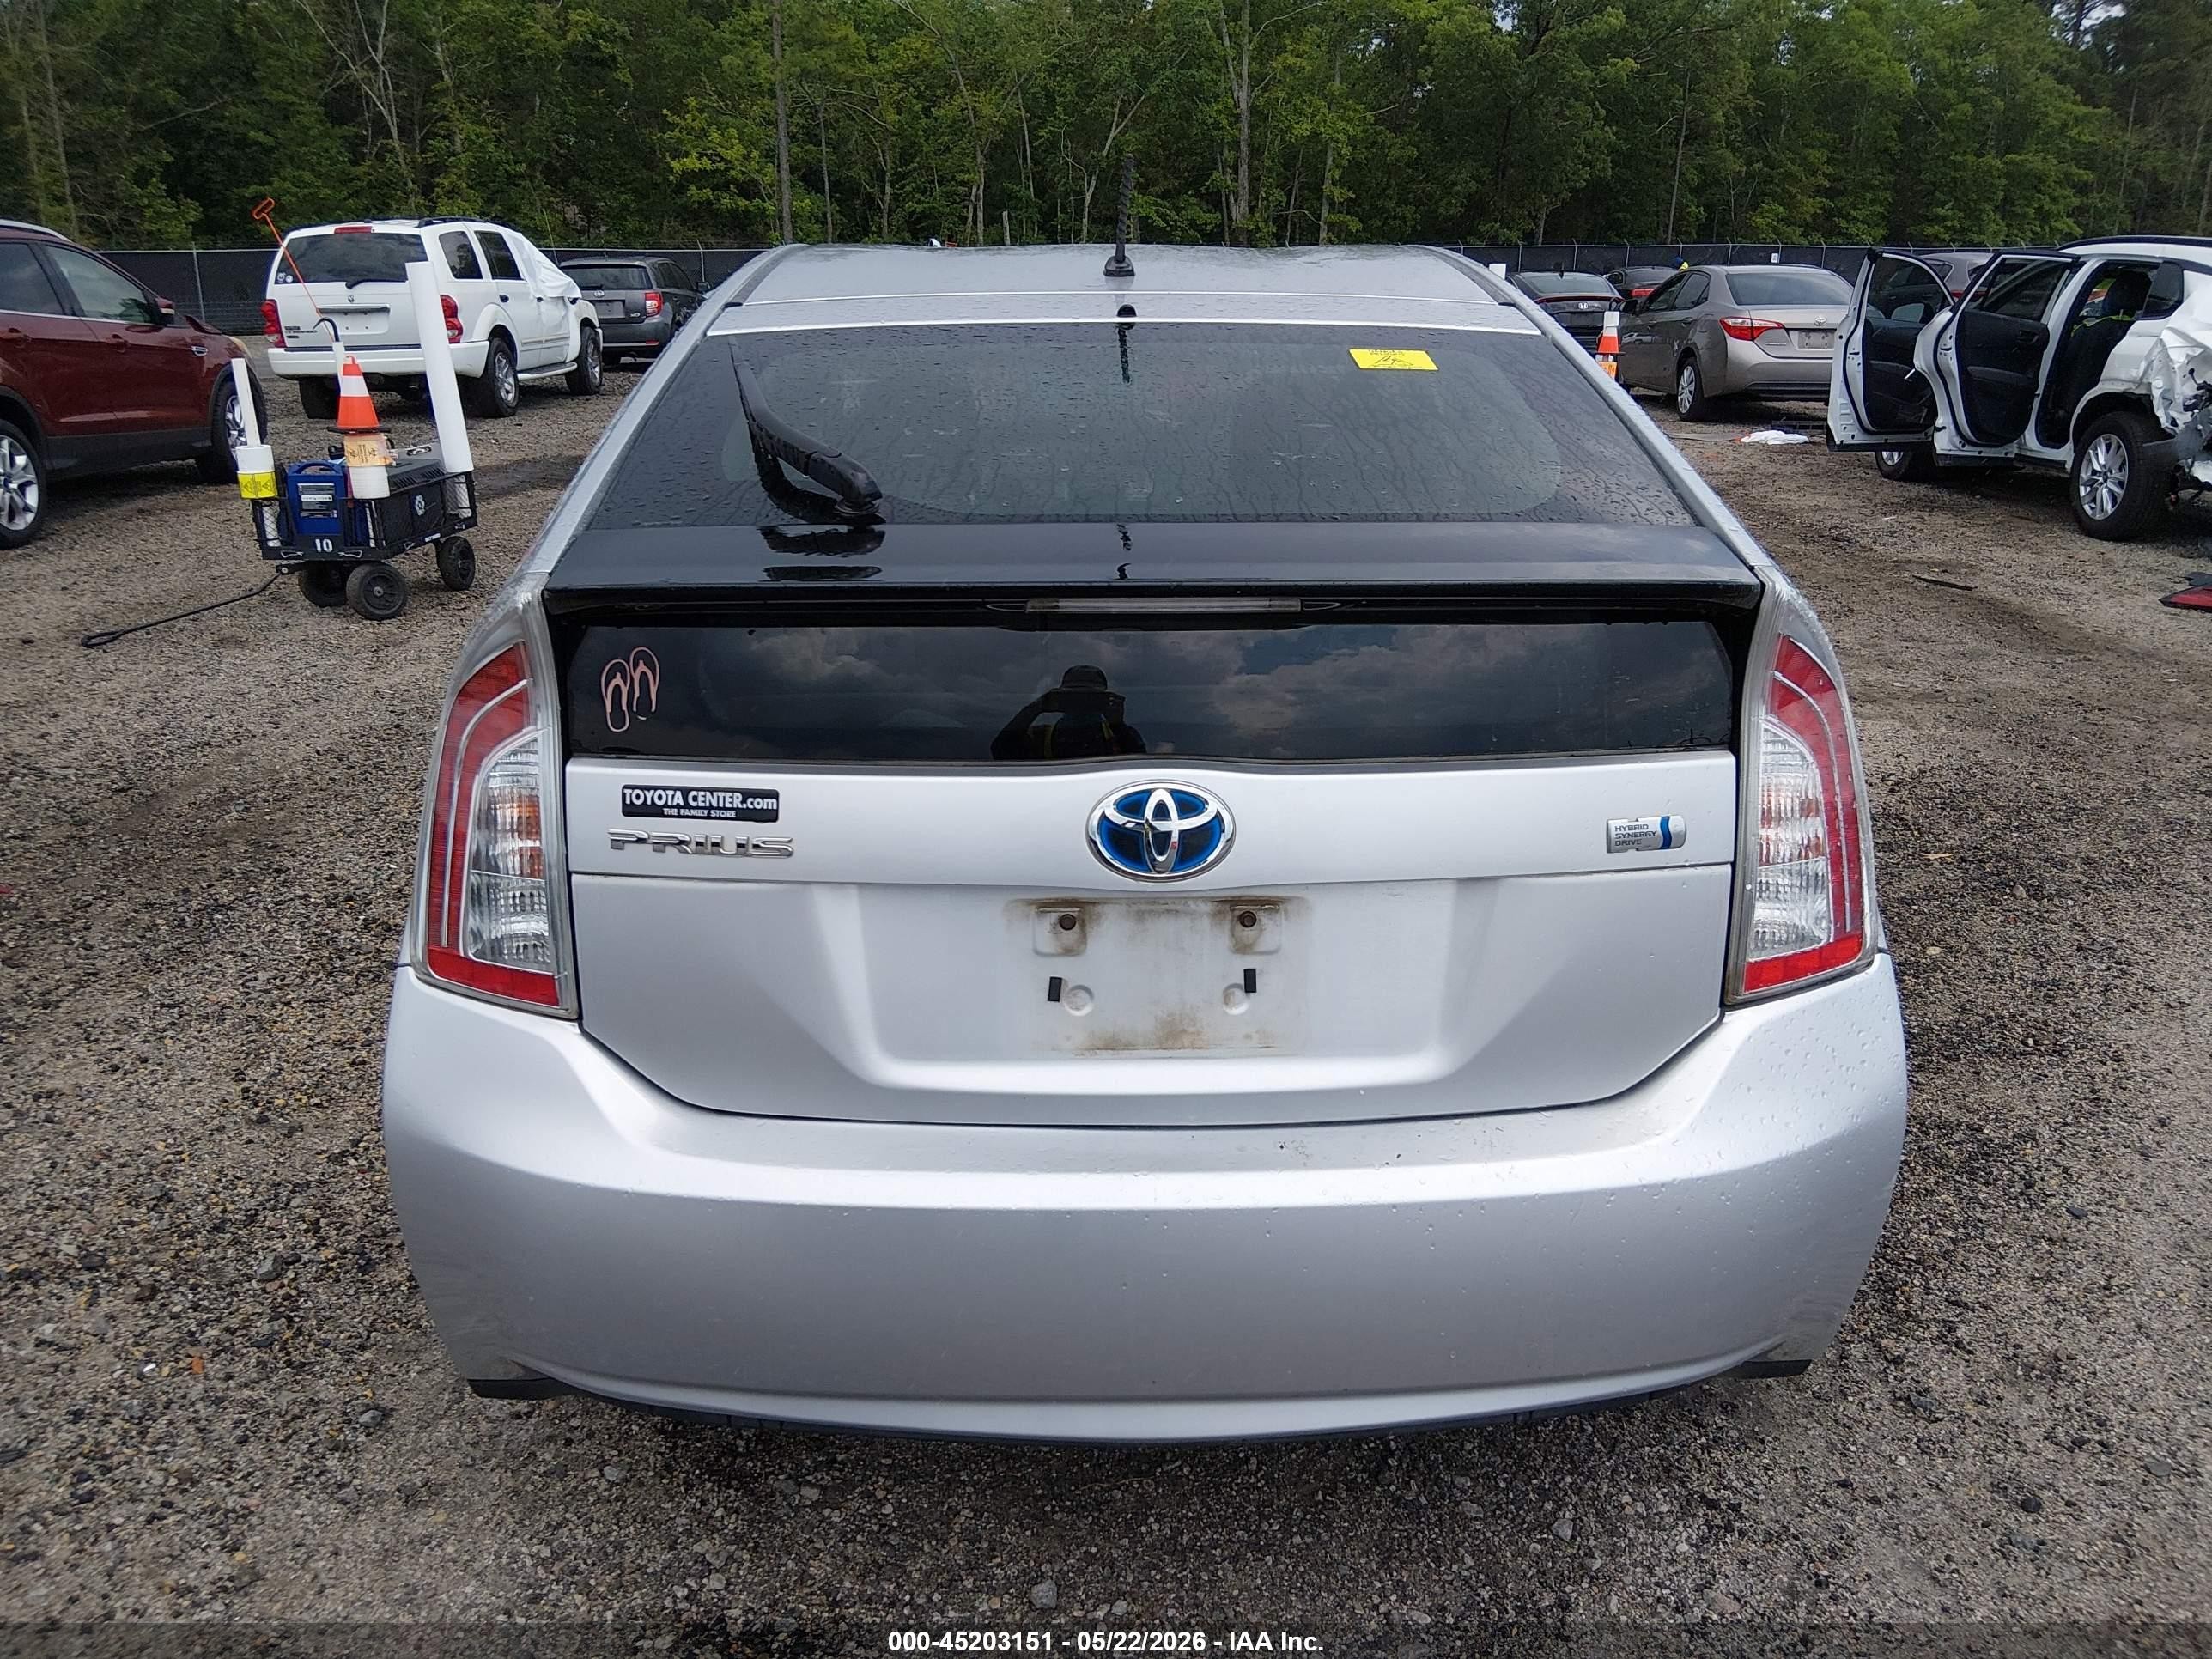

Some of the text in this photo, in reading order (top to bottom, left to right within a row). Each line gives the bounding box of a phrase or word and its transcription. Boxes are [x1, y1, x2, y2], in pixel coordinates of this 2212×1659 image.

[315, 538, 333, 553] 10
[623, 788, 777, 810] TOYOTA CENTER.com
[680, 808, 708, 817] FAMILY
[710, 810, 736, 818] STORE
[1614, 823, 1649, 832] HYBRID
[1614, 830, 1657, 839] SYNERGY
[607, 829, 794, 859] PRIUS
